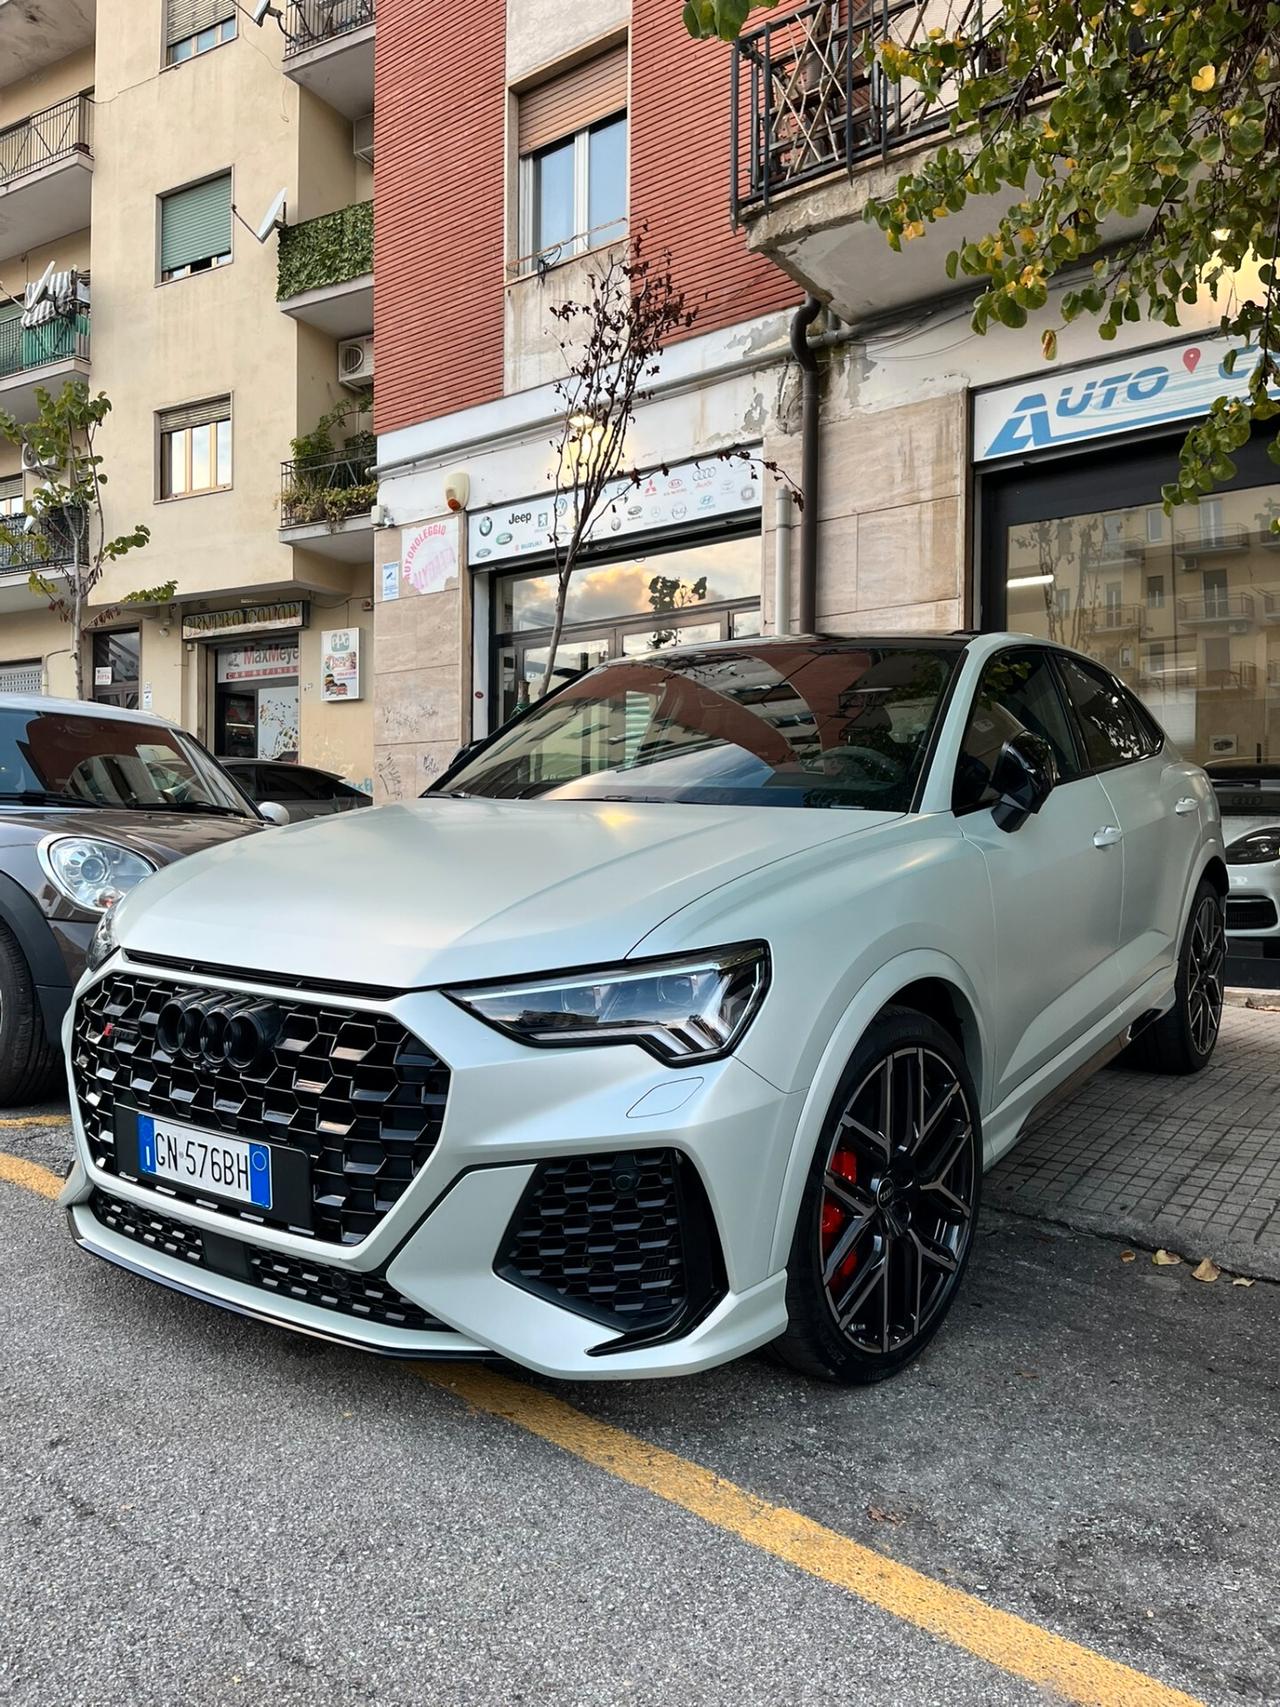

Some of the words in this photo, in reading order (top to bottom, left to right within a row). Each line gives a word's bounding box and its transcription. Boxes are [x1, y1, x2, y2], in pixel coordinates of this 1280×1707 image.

[984, 366, 1169, 457] AUTO
[508, 512, 532, 525] Jeep
[243, 643, 298, 665] MaxMeye
